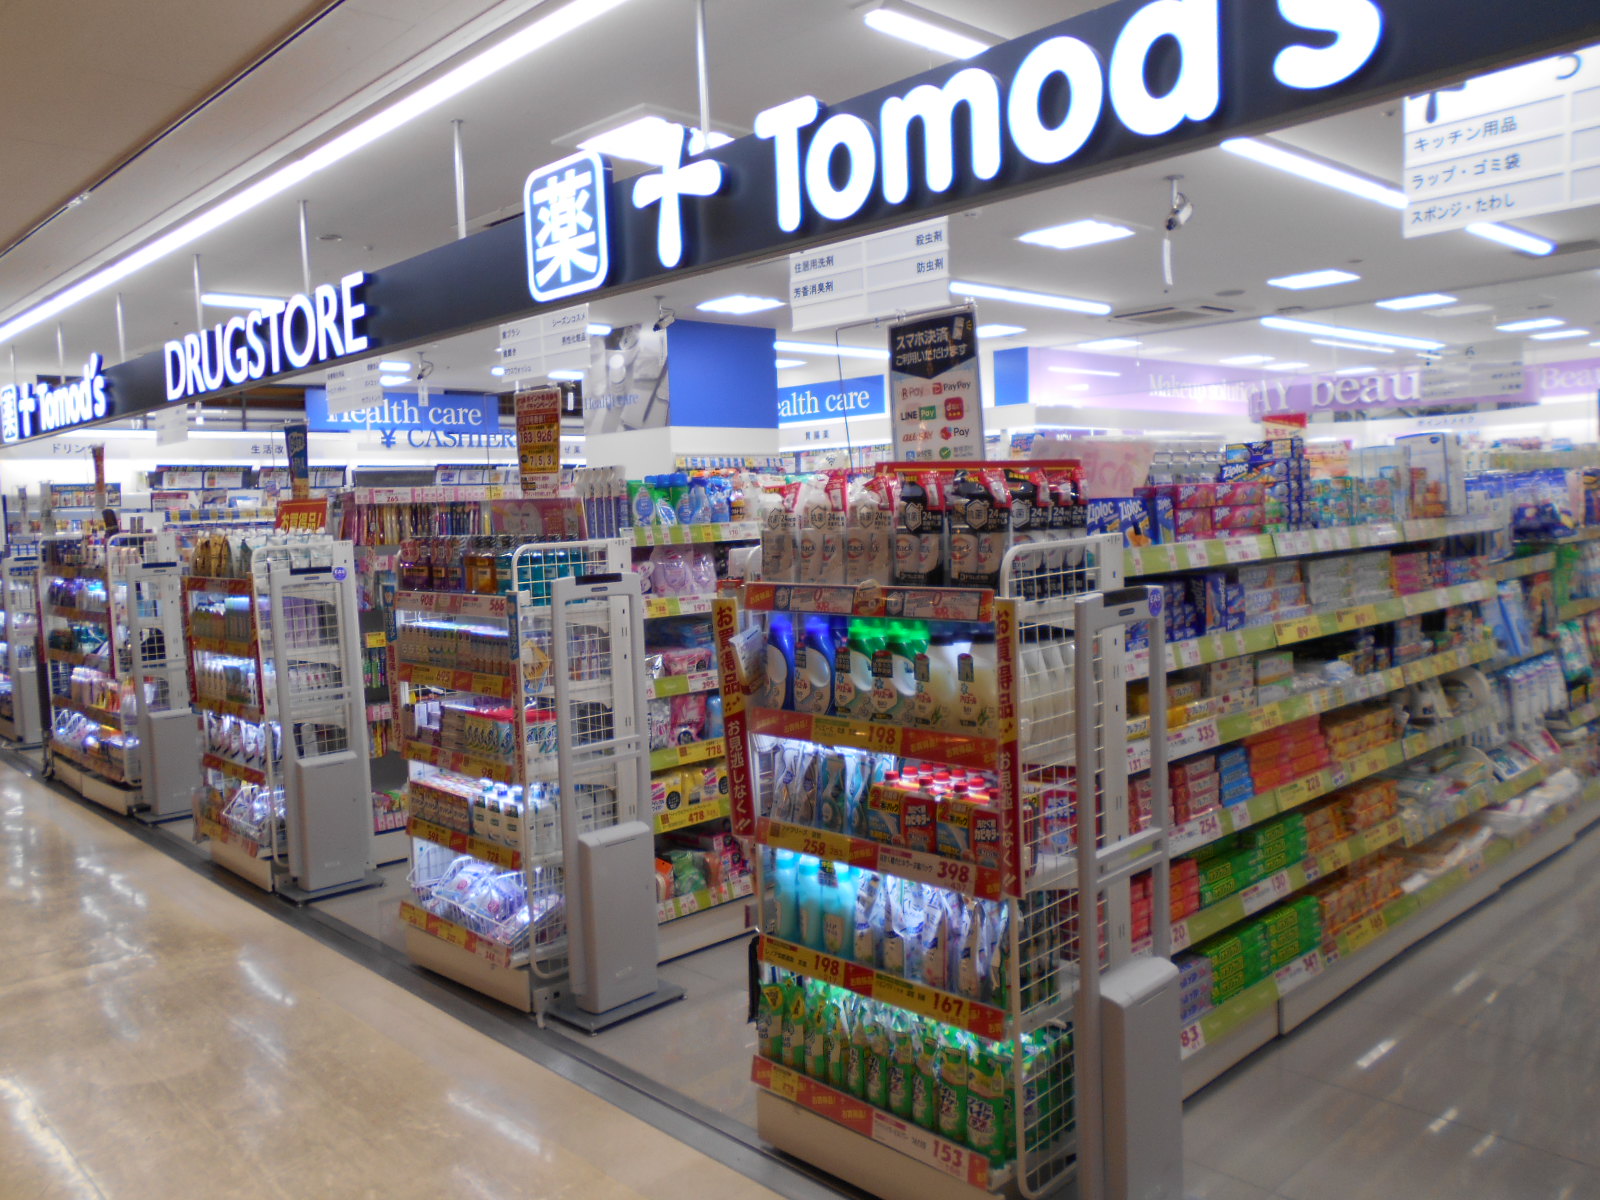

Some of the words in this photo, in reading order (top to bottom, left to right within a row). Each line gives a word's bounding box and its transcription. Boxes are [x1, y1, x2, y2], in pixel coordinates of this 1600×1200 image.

[754, 0, 1382, 234] Tomods
[1414, 115, 1518, 151] キッチン用品
[1412, 153, 1521, 189] ラップ・ゴミ袋
[1411, 193, 1516, 225] スポンジ・たわし
[532, 167, 599, 288] 薬
[915, 230, 943, 246] 殺虫剤
[916, 258, 944, 274] 防虫剤
[164, 271, 368, 400] DRUGSTORE
[896, 327, 950, 350] スマホ決済
[895, 343, 969, 366] ご利用いただけます
[943, 381, 971, 392] PayPay
[1541, 366, 1600, 390] Bea
[36, 352, 107, 431] Tomod's
[825, 389, 870, 412] care
[428, 404, 483, 426] care
[900, 410, 918, 421] LINE
[408, 428, 517, 448] CASHIER
[953, 428, 970, 440] Pay
[1223, 463, 1249, 479] Ziploc
[1087, 502, 1114, 524] Ziploc
[1119, 500, 1143, 522] Ziploc
[867, 725, 897, 745] 198
[1196, 725, 1215, 742] 335
[705, 744, 722, 757] 778
[689, 810, 705, 823] 478
[1200, 816, 1217, 835] 254
[804, 838, 826, 856] 258
[937, 861, 970, 882] 398
[814, 955, 839, 976] 198
[933, 992, 964, 1016] 167
[933, 1139, 963, 1167] 153
